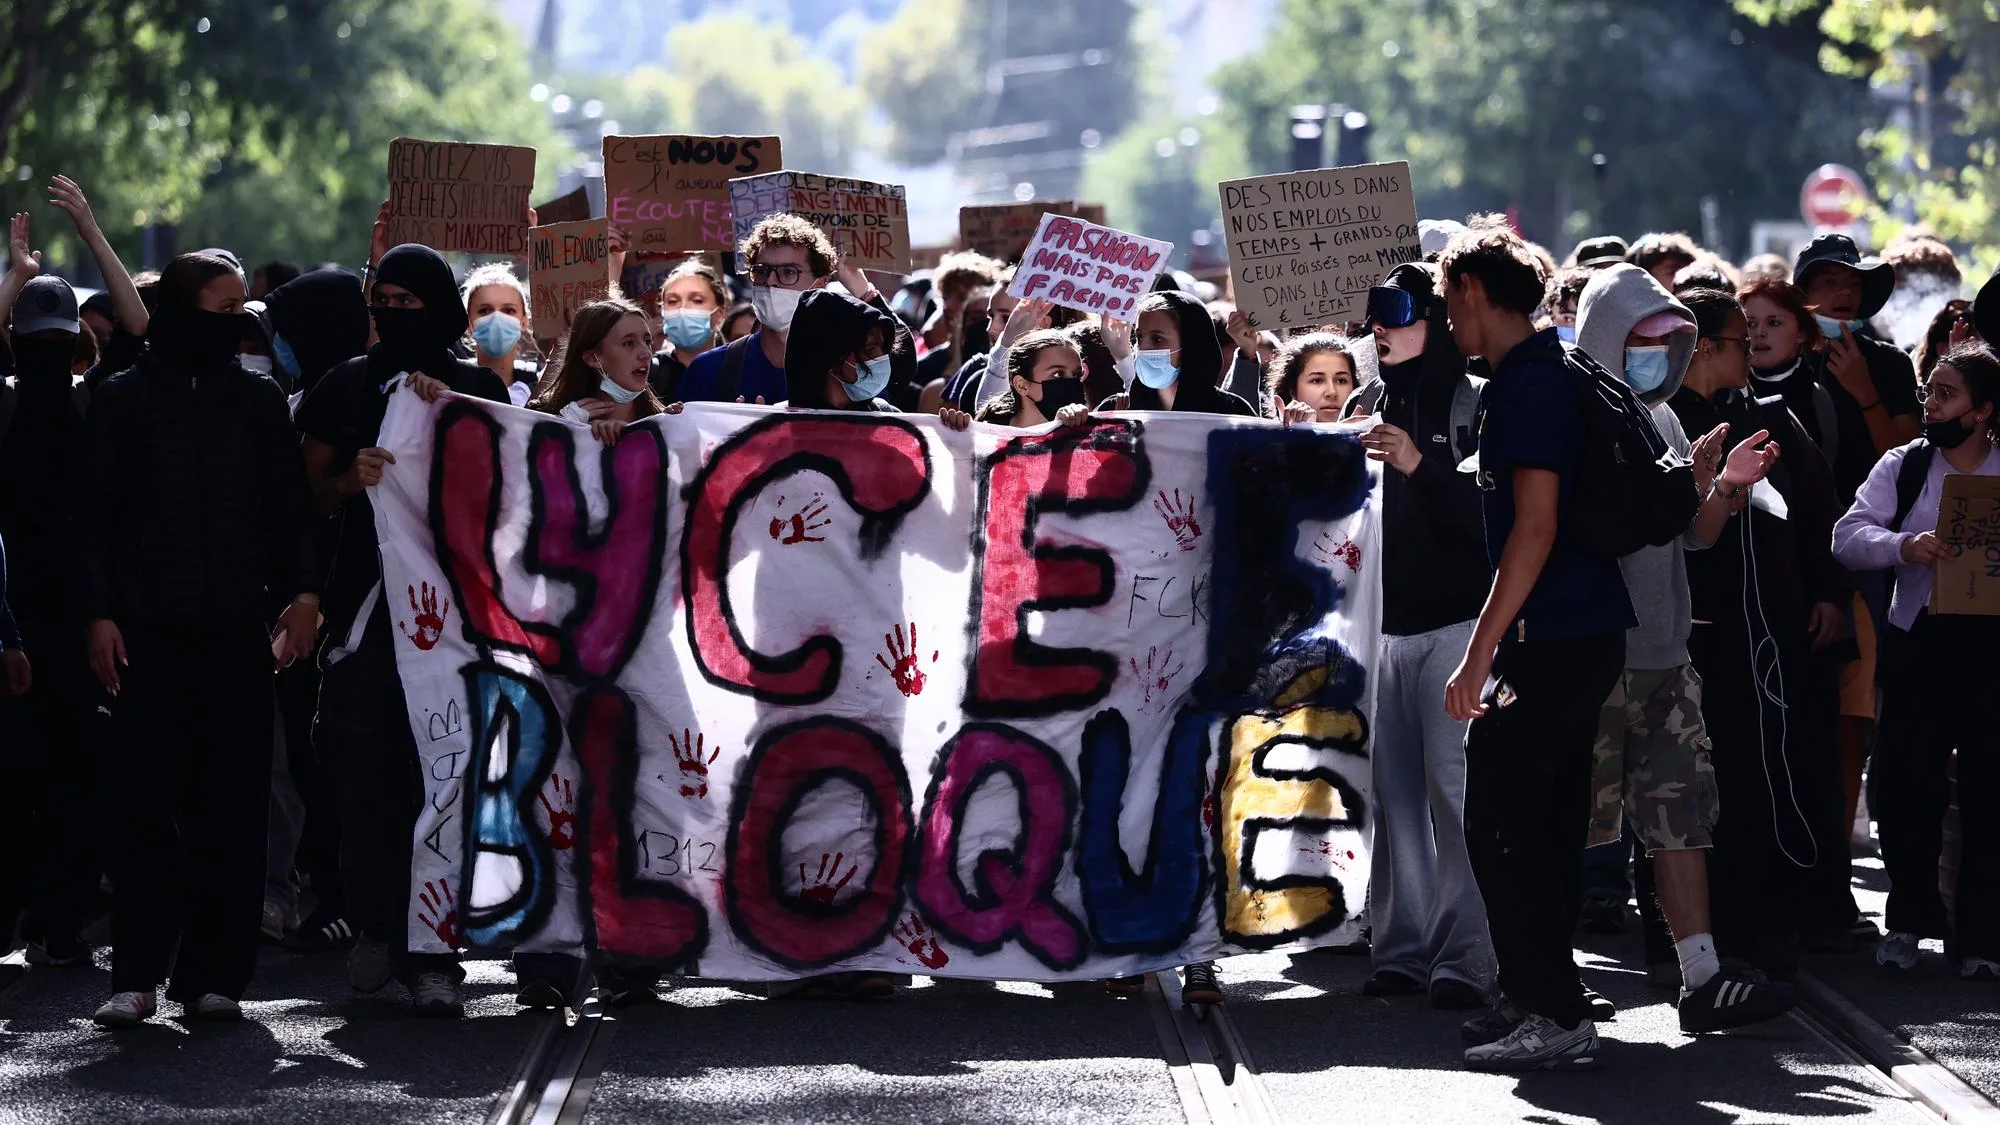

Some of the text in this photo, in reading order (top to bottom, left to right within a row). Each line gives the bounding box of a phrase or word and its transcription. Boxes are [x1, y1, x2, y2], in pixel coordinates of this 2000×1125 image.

[389, 141, 512, 182] RECYCLEZ VOS
[611, 137, 762, 173] C'est NOUS
[390, 181, 457, 219] DECHETS
[734, 188, 903, 218] DERANGEMENT
[825, 178, 874, 196] POUR
[1226, 176, 1400, 210] DES TROUS DANS
[612, 188, 732, 225] ÉCOUTEZ
[863, 214, 890, 228] DE
[1232, 205, 1381, 234] NOS EMPLOIS DU
[534, 237, 559, 272] MAL
[1236, 224, 1418, 258] TEMPS + GRANDS QUE
[1096, 265, 1144, 294] PAS
[1242, 264, 1283, 283] CEUX
[1290, 256, 1339, 276] laissés
[1349, 253, 1373, 270] par
[534, 281, 559, 319] PAS
[1024, 274, 1135, 316] FACHO!
[1263, 284, 1306, 307] DANS
[1313, 280, 1328, 298] LA
[1127, 573, 1208, 629] FCK
[423, 698, 466, 864] ACAB
[637, 829, 719, 876] 1312
